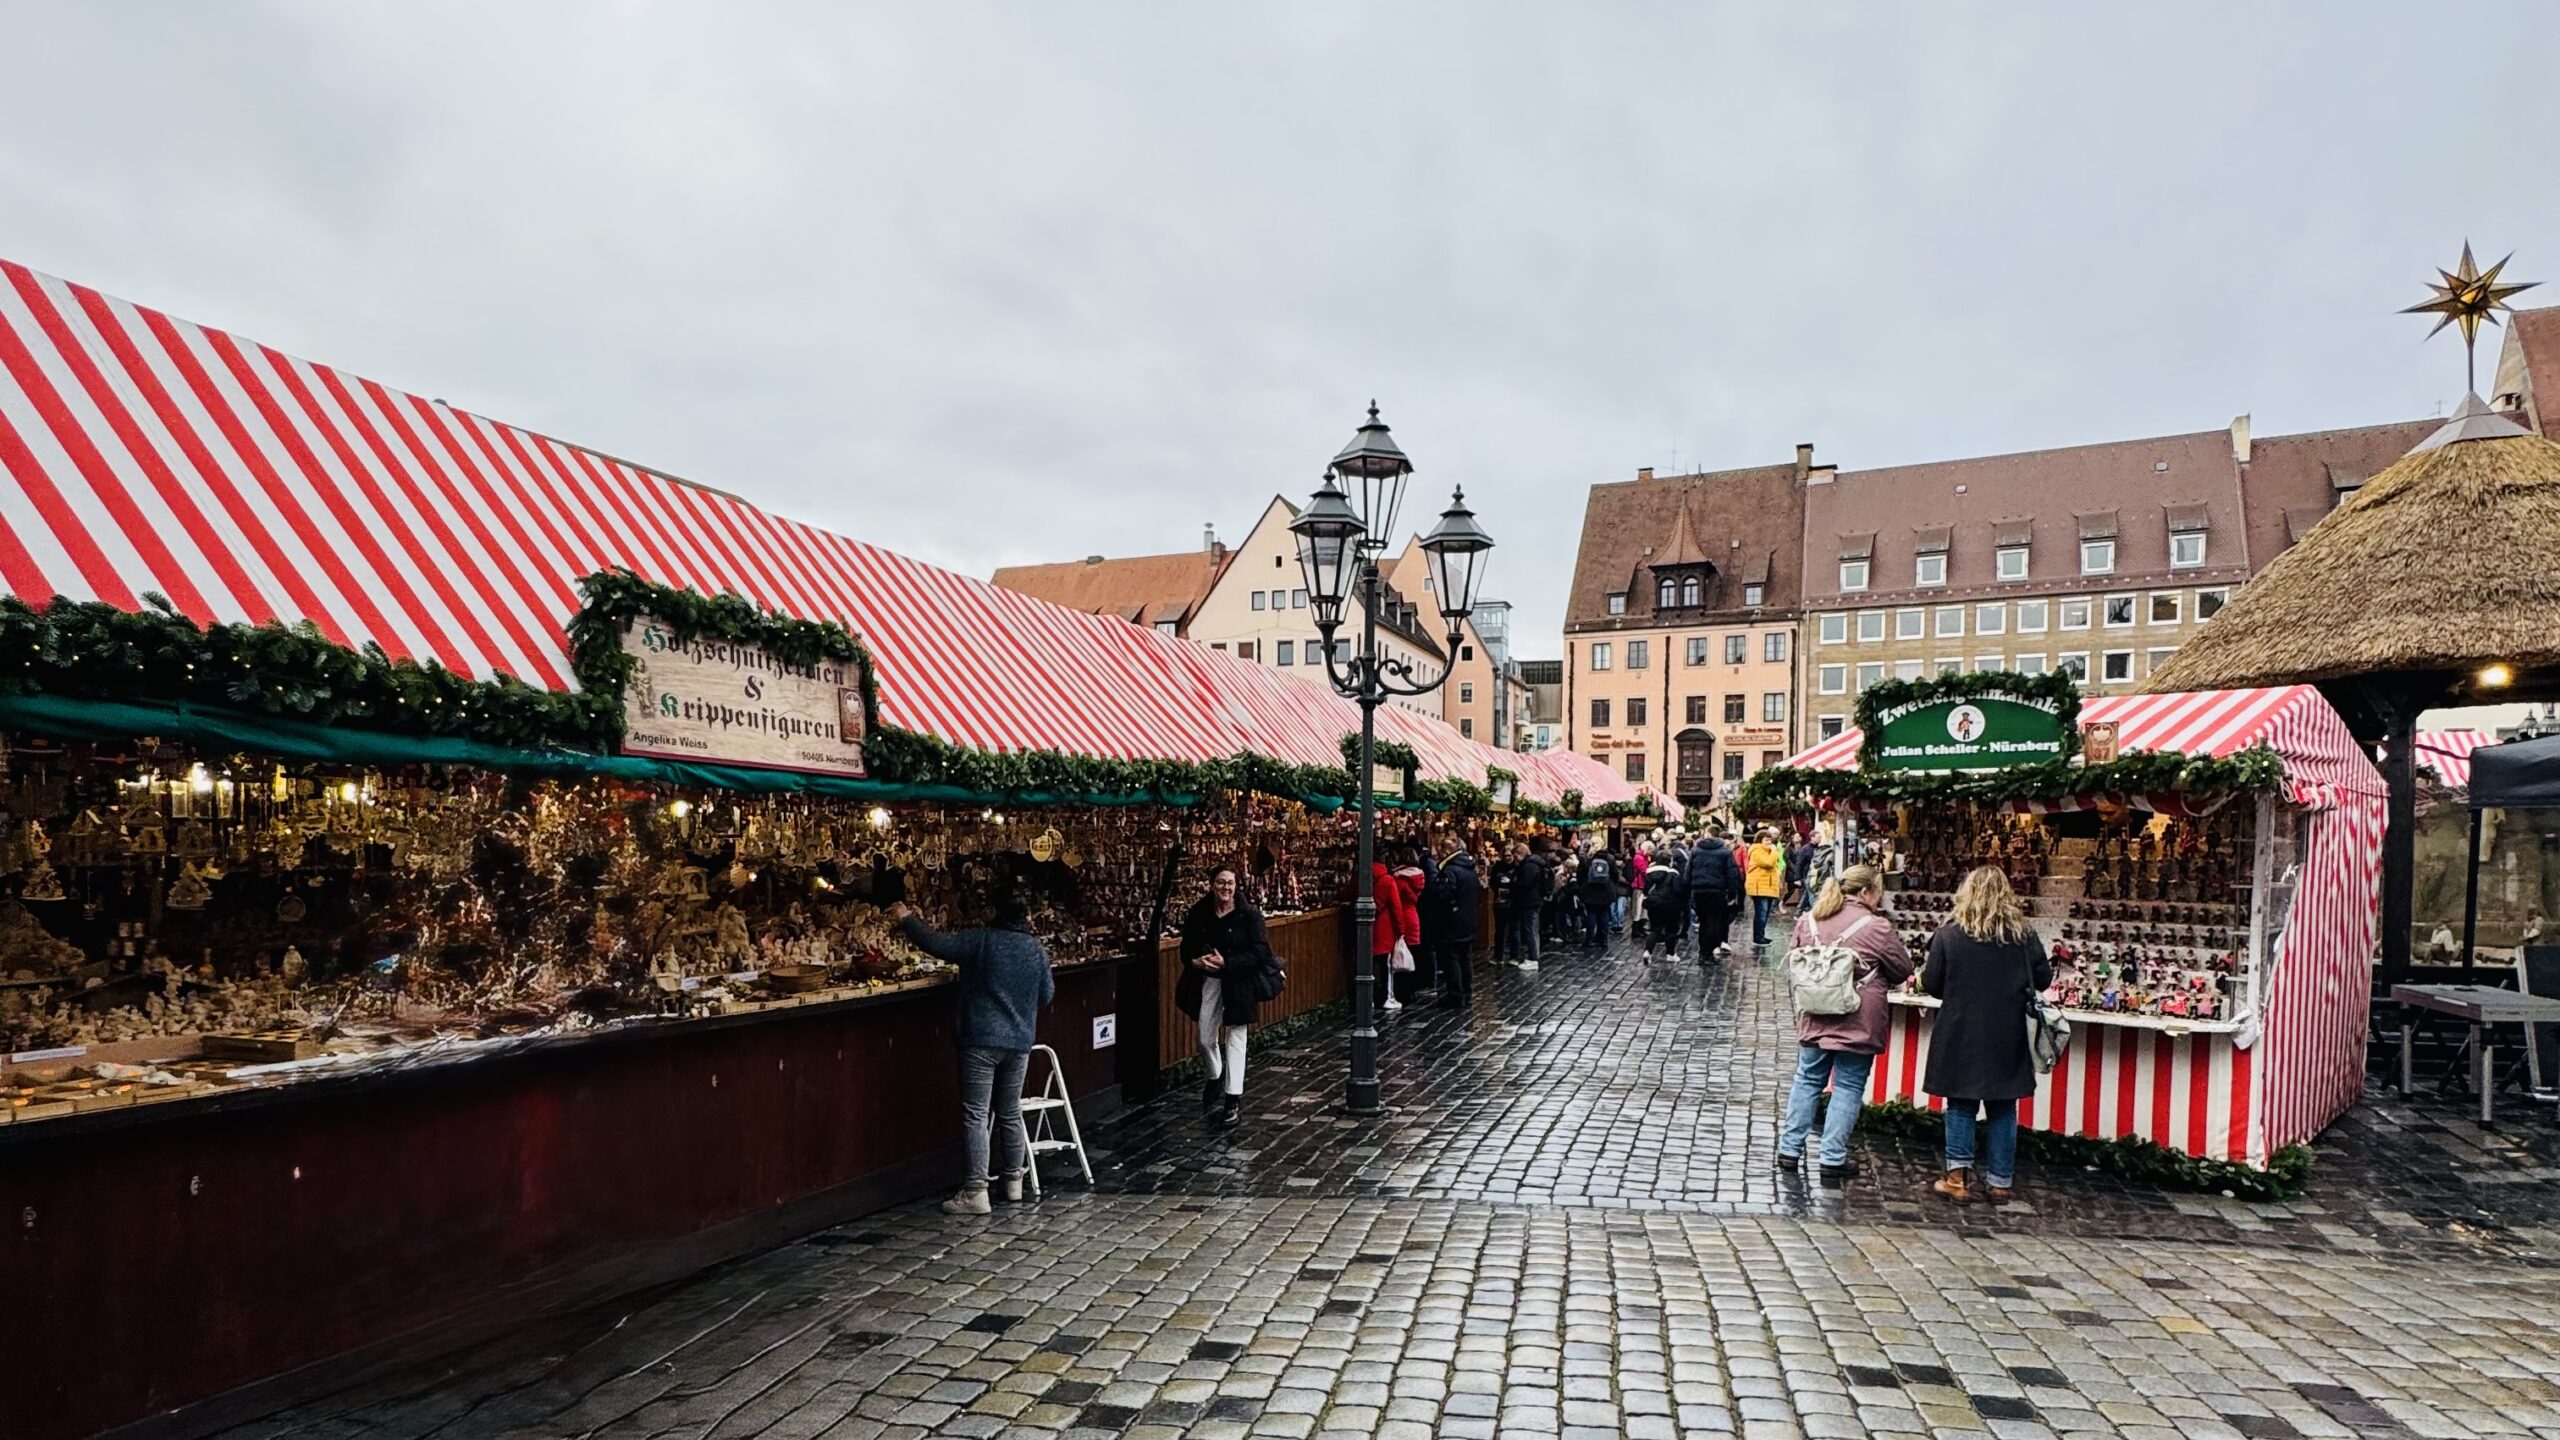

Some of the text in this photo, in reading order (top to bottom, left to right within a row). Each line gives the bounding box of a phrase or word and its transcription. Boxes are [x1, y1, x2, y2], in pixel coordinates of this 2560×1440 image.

[744, 675, 764, 701] &
[660, 692, 836, 740] Krippenfiguren
[633, 731, 708, 749] Angelika Weiss
[1881, 746, 1923, 757] Julian
[1925, 744, 1980, 756] Scheller
[1989, 741, 2060, 753] Nürnberg
